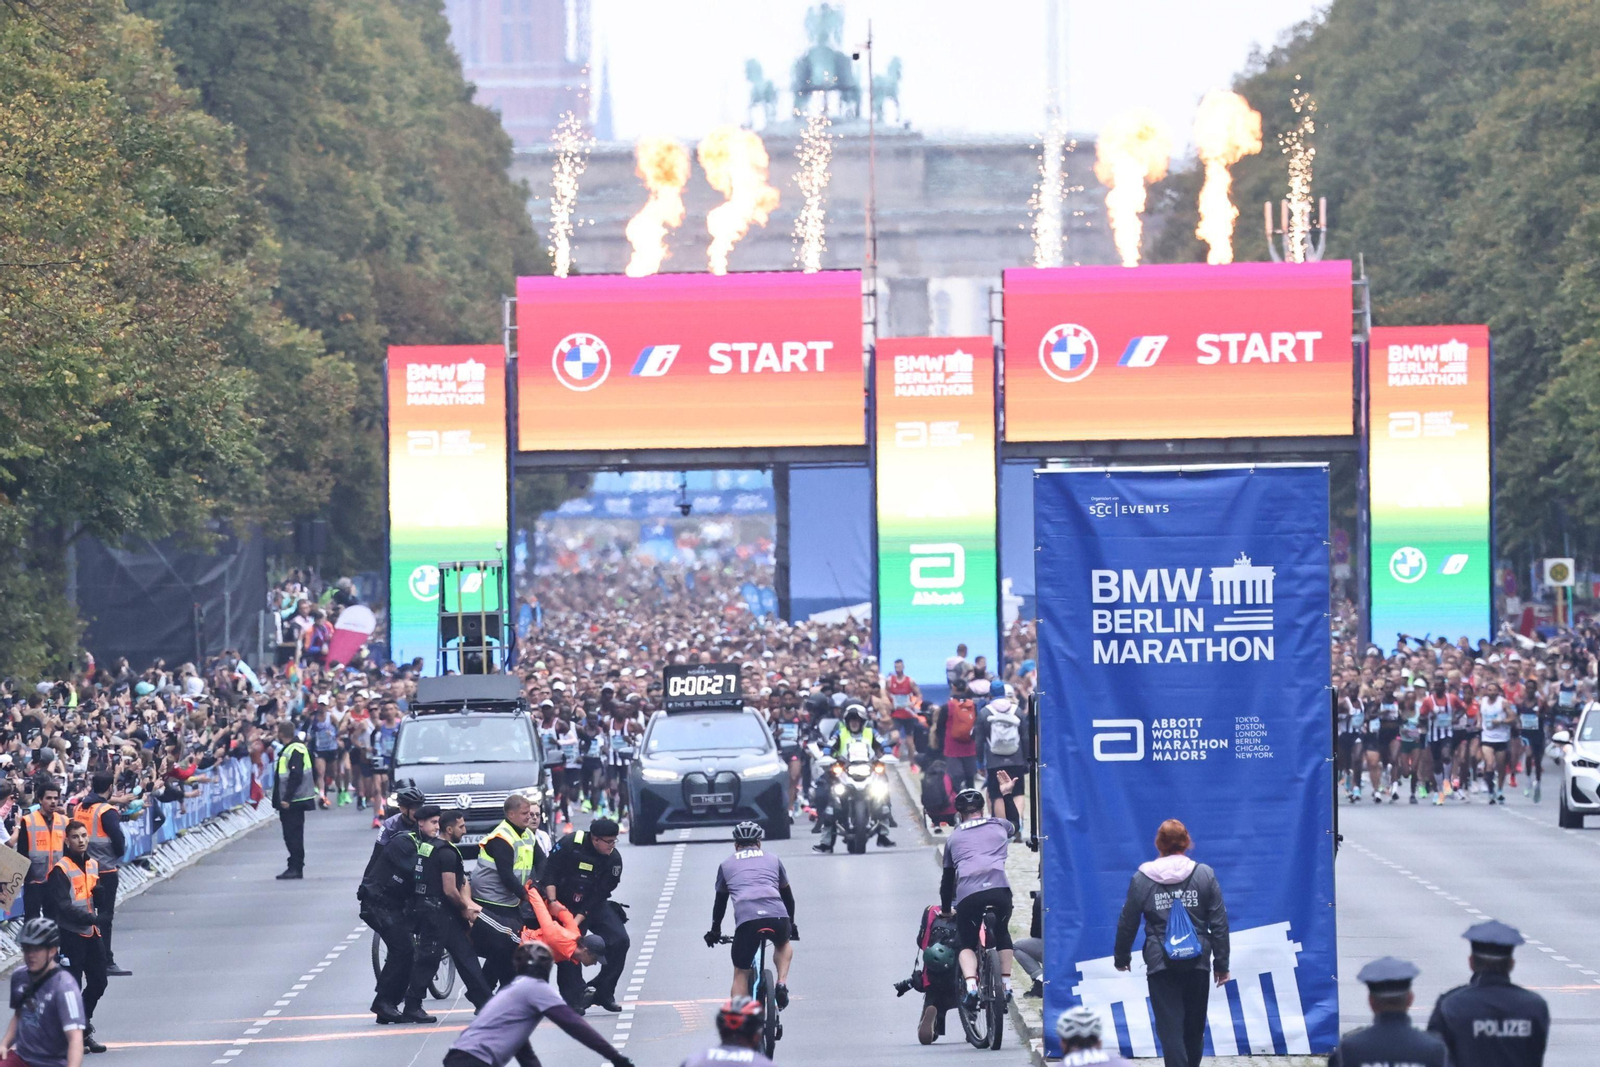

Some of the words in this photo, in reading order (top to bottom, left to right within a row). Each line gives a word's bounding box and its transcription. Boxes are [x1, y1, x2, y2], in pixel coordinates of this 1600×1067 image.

[1196, 331, 1322, 364] START
[1388, 344, 1438, 362] BMW
[708, 341, 833, 374] START
[894, 355, 944, 372] BMW
[406, 363, 456, 381] BMW
[1388, 361, 1438, 374] BERLIN
[894, 372, 945, 384] BERLIN
[1388, 373, 1467, 387] MARATHON
[894, 384, 974, 397] MARATHON
[406, 393, 485, 405] MARATHON
[1089, 504, 1112, 516] SCC
[1121, 504, 1170, 514] EVENTS
[1091, 568, 1203, 603] BMW
[1092, 608, 1204, 634] BERLIN
[1093, 636, 1275, 664] MARATHON
[669, 674, 736, 697] 0:00:27
[1151, 718, 1203, 728] ABBOTT
[1151, 729, 1199, 739] WORLD
[1152, 739, 1229, 750] MARATHON
[1152, 750, 1207, 761] MAJORS
[960, 819, 987, 830] TEAM
[735, 849, 764, 860] TEAM
[1186, 890, 1198, 899] 20
[1187, 899, 1199, 907] 23
[1473, 1020, 1532, 1037] POLIZEI
[707, 1048, 754, 1063] TEAM
